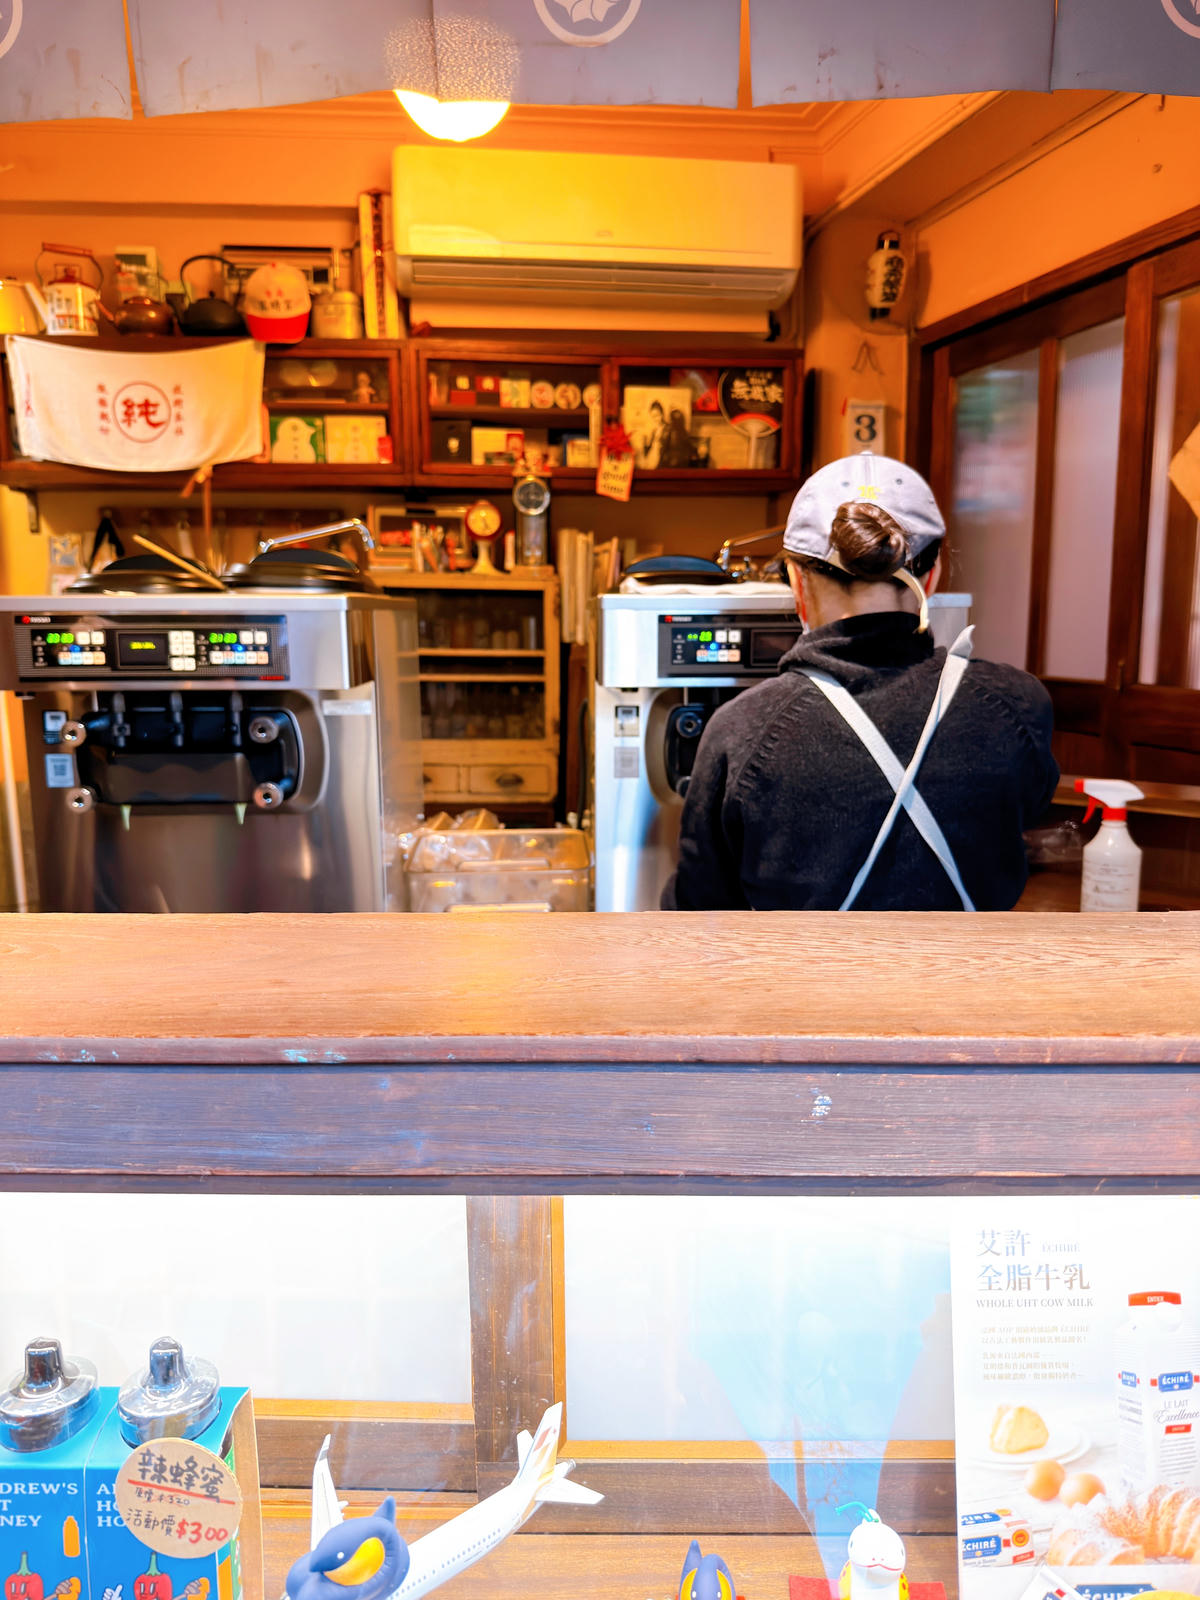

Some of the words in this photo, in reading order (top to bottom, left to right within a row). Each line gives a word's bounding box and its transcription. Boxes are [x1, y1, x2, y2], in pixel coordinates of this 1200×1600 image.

[120, 398, 167, 428] 純
[854, 414, 877, 443] 3
[976, 1229, 1031, 1257] 艾許
[976, 1263, 1091, 1291] 全脂牛乳
[976, 1298, 1013, 1308] WHOLE
[1016, 1298, 1038, 1308] UHT
[1041, 1298, 1064, 1308] COW
[1067, 1298, 1094, 1307] MILK
[1162, 1374, 1190, 1385] ÉCHIRÉ
[137, 1448, 224, 1503] 辣蜂蜜
